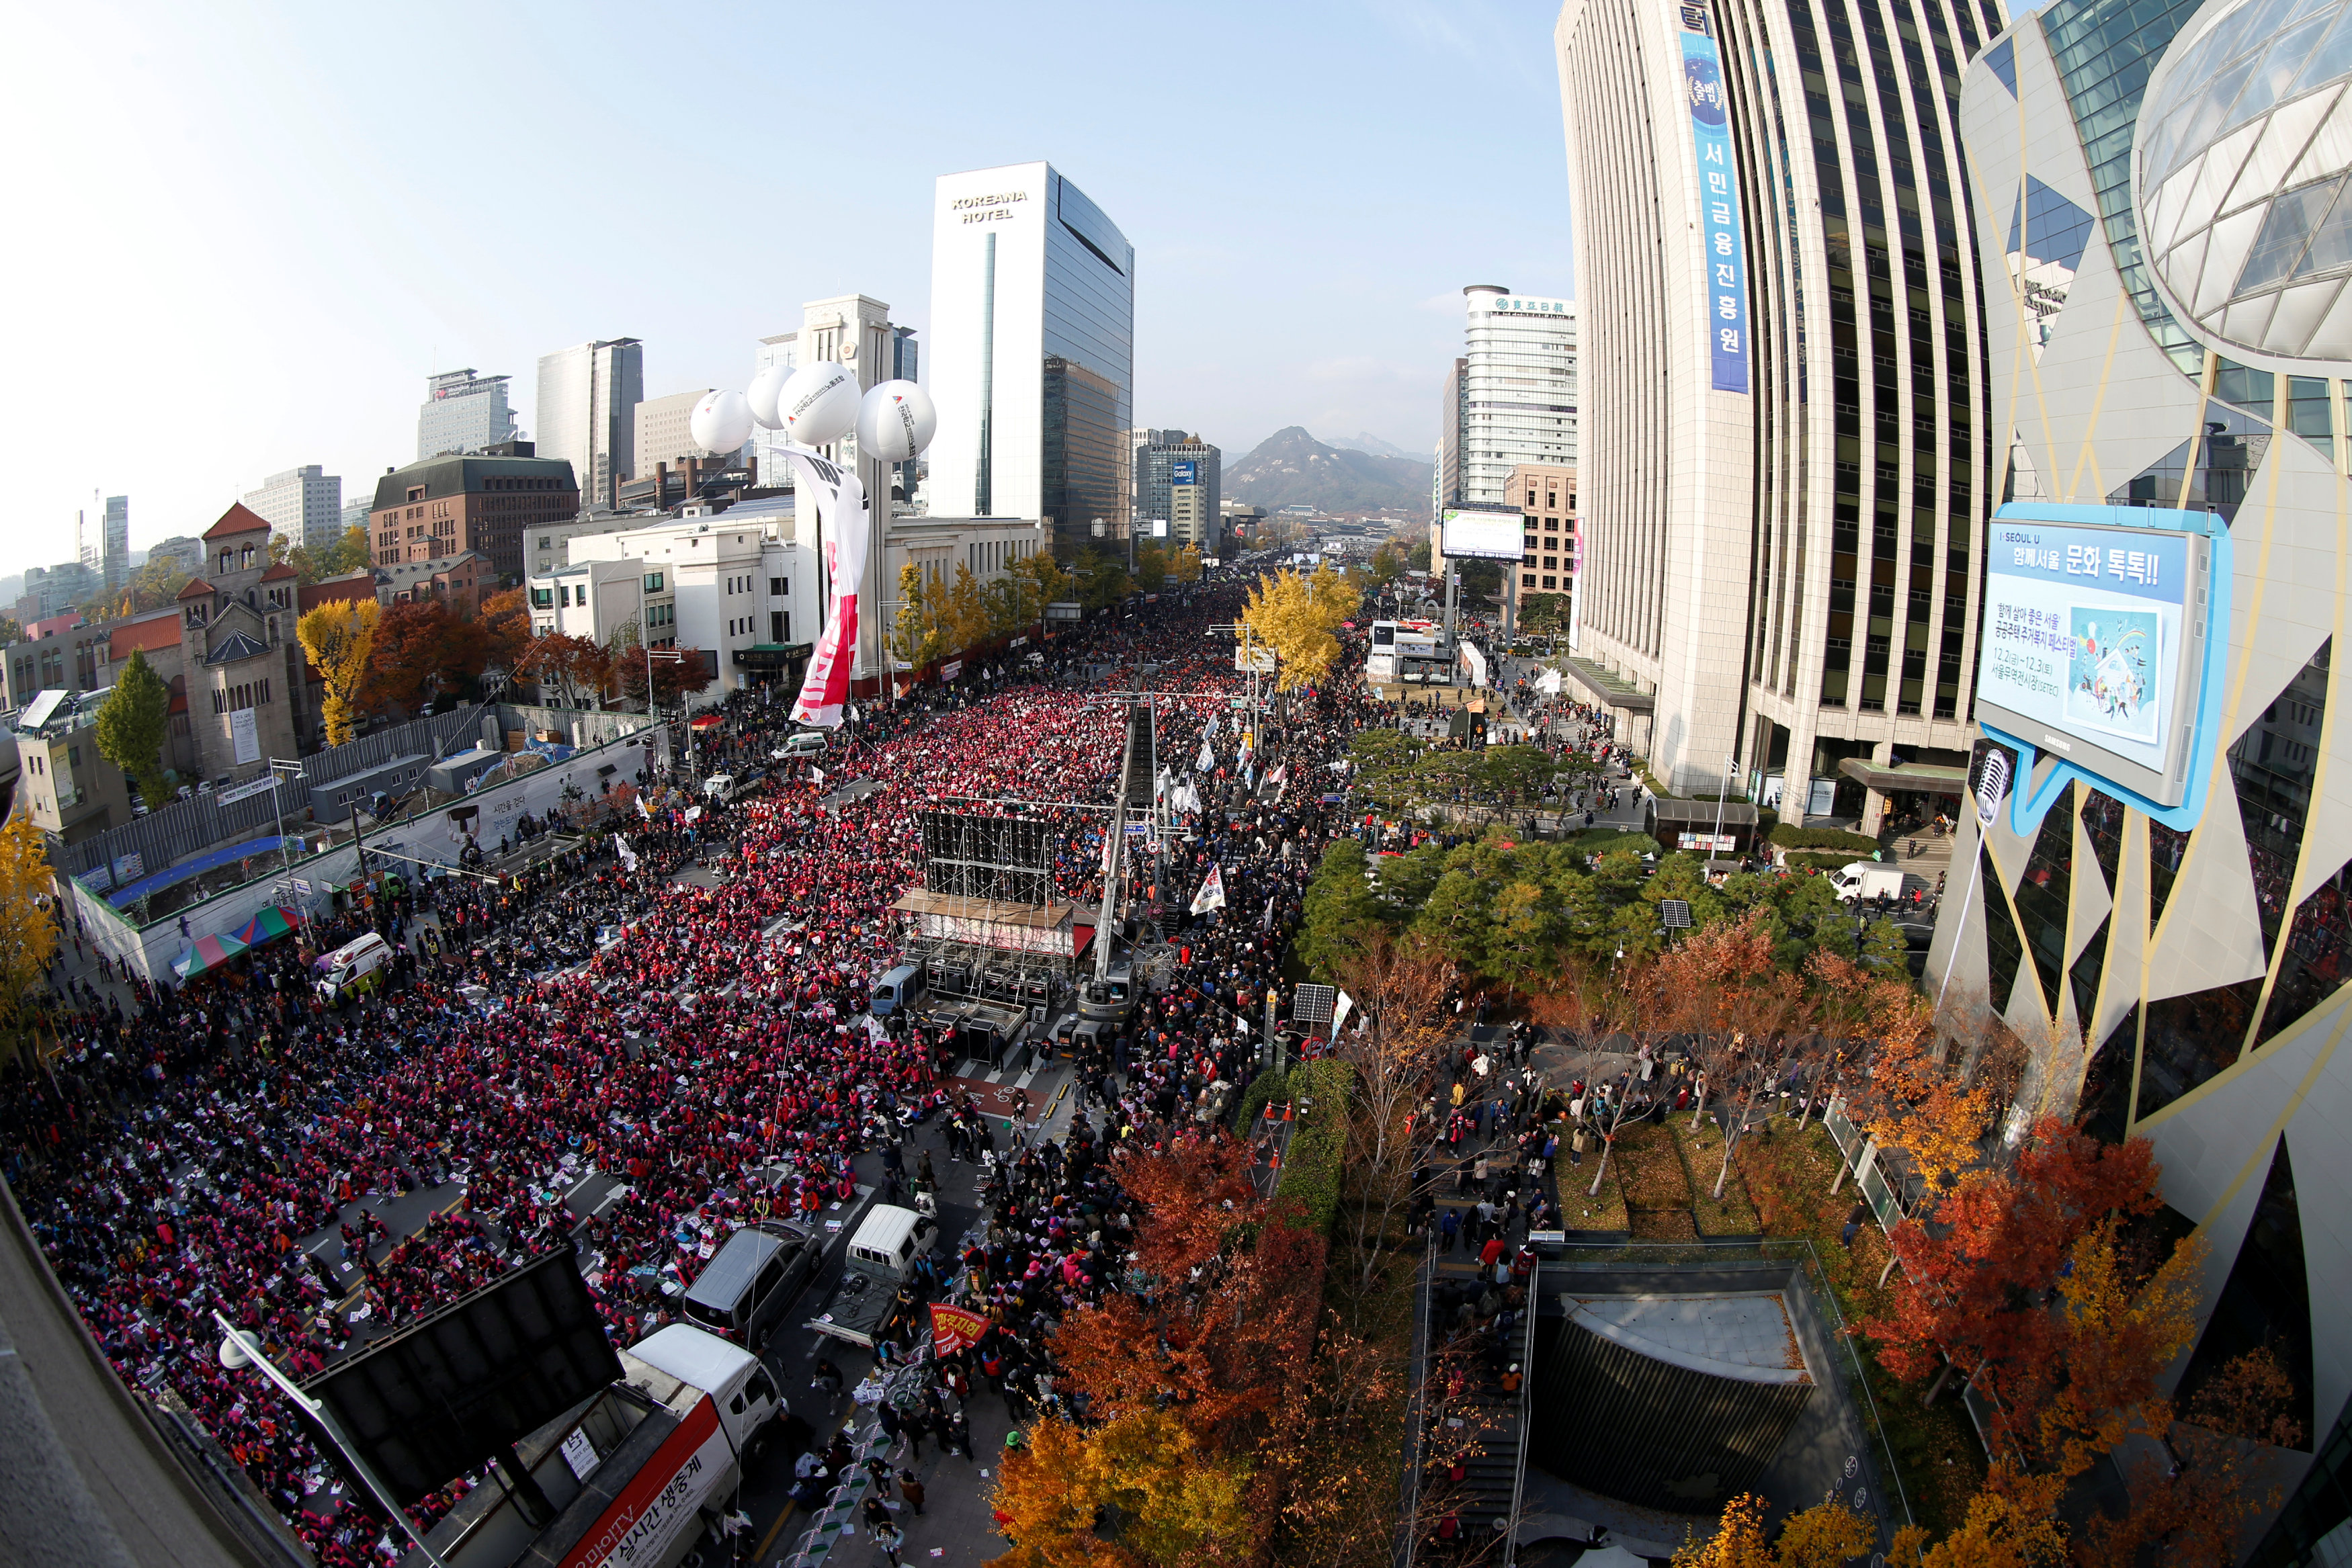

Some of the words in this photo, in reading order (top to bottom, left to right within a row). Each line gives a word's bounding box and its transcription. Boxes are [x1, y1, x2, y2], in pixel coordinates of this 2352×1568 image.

[1680, 0, 1710, 36] 터
[1693, 80, 1716, 103] 출범
[951, 190, 1027, 210] KOREANA
[962, 208, 1013, 224] HOTEL
[1705, 142, 1739, 353] 서민금융진흥원
[1174, 470, 1192, 478] Galaxy
[2013, 546, 2060, 571] 함께서울
[2066, 544, 2101, 578] 문화
[2107, 548, 2160, 586] 톡톡!!
[2013, 605, 2027, 623] 살아
[2028, 608, 2043, 626] 좋은
[1995, 620, 2021, 643] 공공주택
[2021, 626, 2048, 650] 주거복지
[2048, 633, 2077, 658] 페스티벌
[2044, 733, 2071, 752] SAMSUNG
[494, 800, 512, 814] 시간을
[619, 1505, 663, 1562] 실시간
[661, 1455, 702, 1509] 생중계
